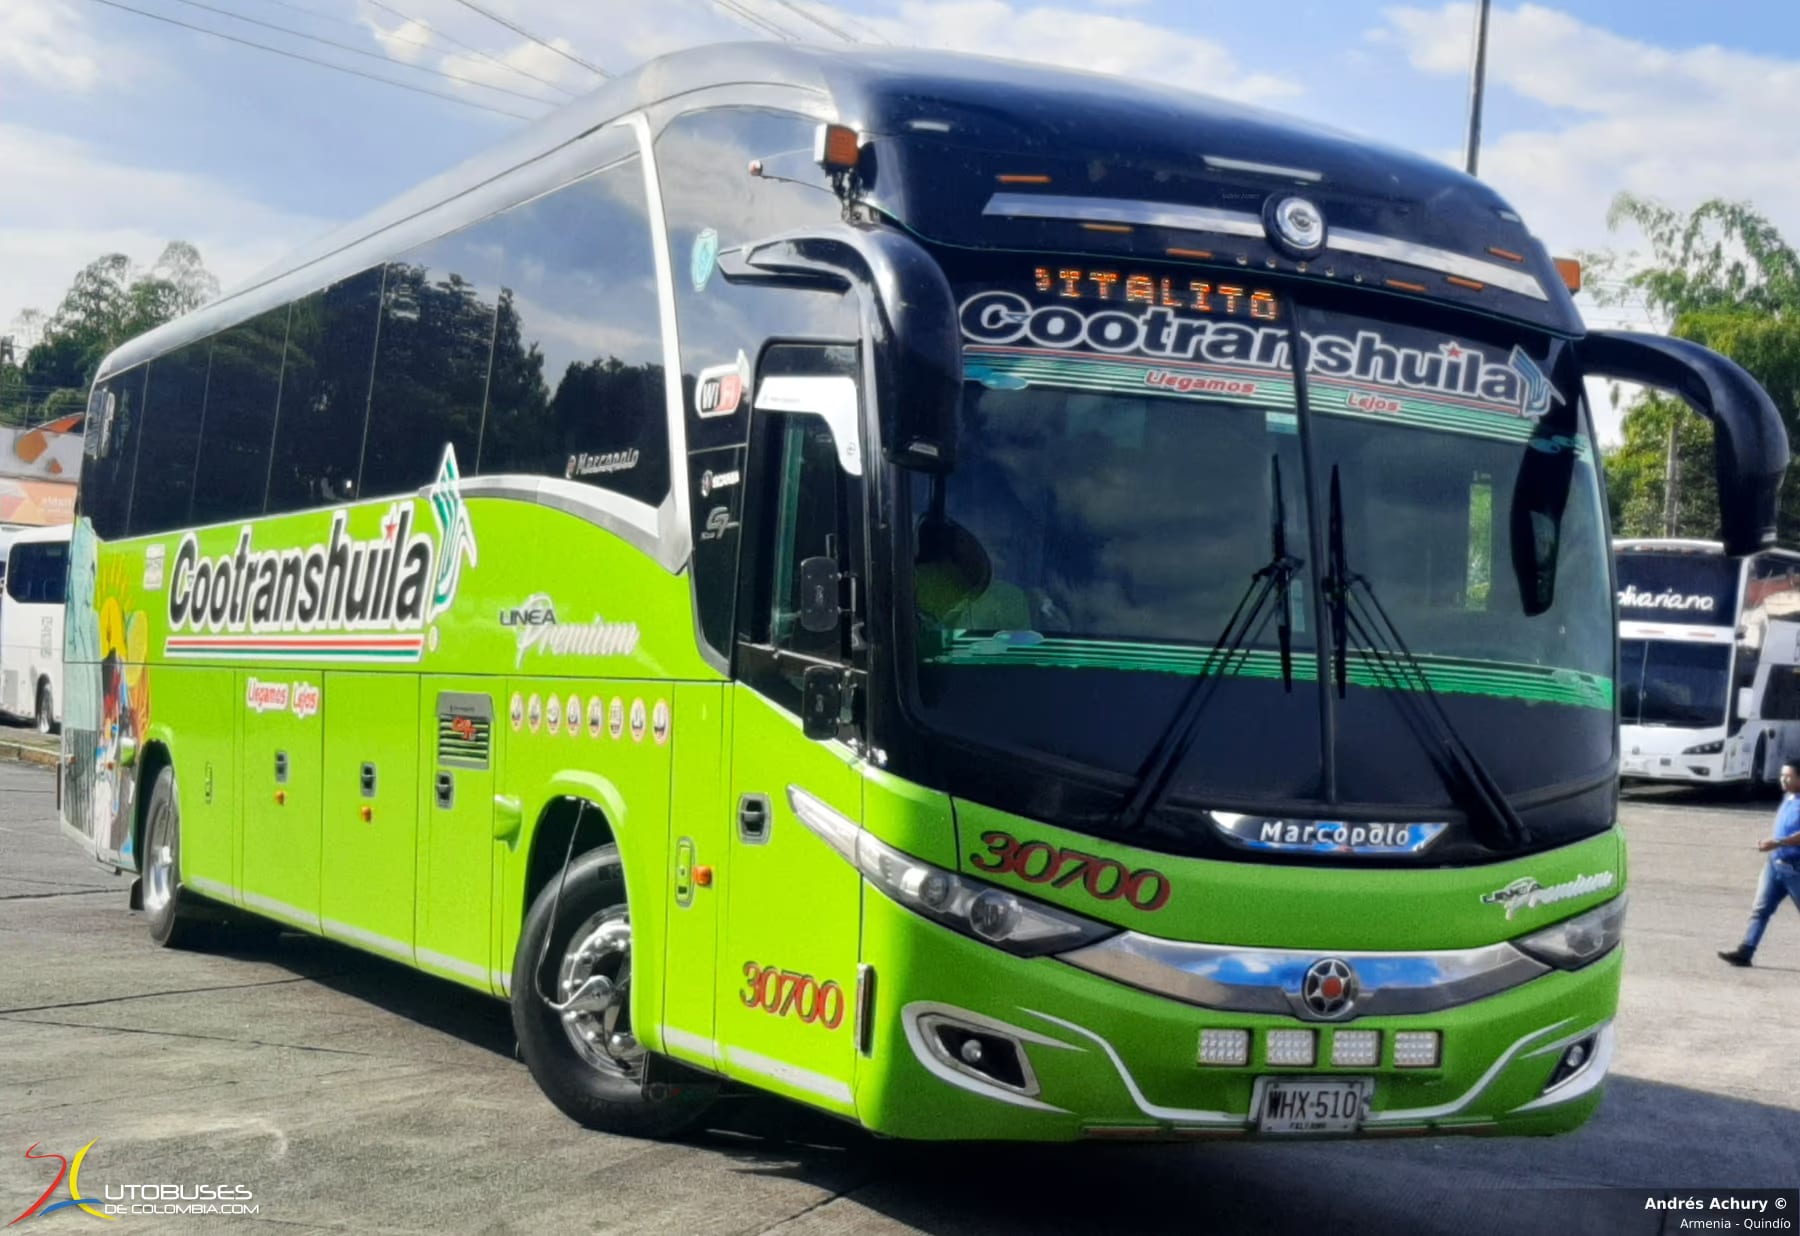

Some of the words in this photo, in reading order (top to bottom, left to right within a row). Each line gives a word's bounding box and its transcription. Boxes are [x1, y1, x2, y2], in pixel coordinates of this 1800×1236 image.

[959, 290, 1521, 403] Cootranshuila
[1145, 370, 1256, 395] Llegamos
[1345, 390, 1400, 414] Lejos
[169, 502, 434, 632] Cootranshuila
[499, 608, 557, 626] LINEA
[1259, 820, 1410, 846] Marcopolo
[969, 830, 1172, 911] 30700
[740, 961, 845, 1030] 30700
